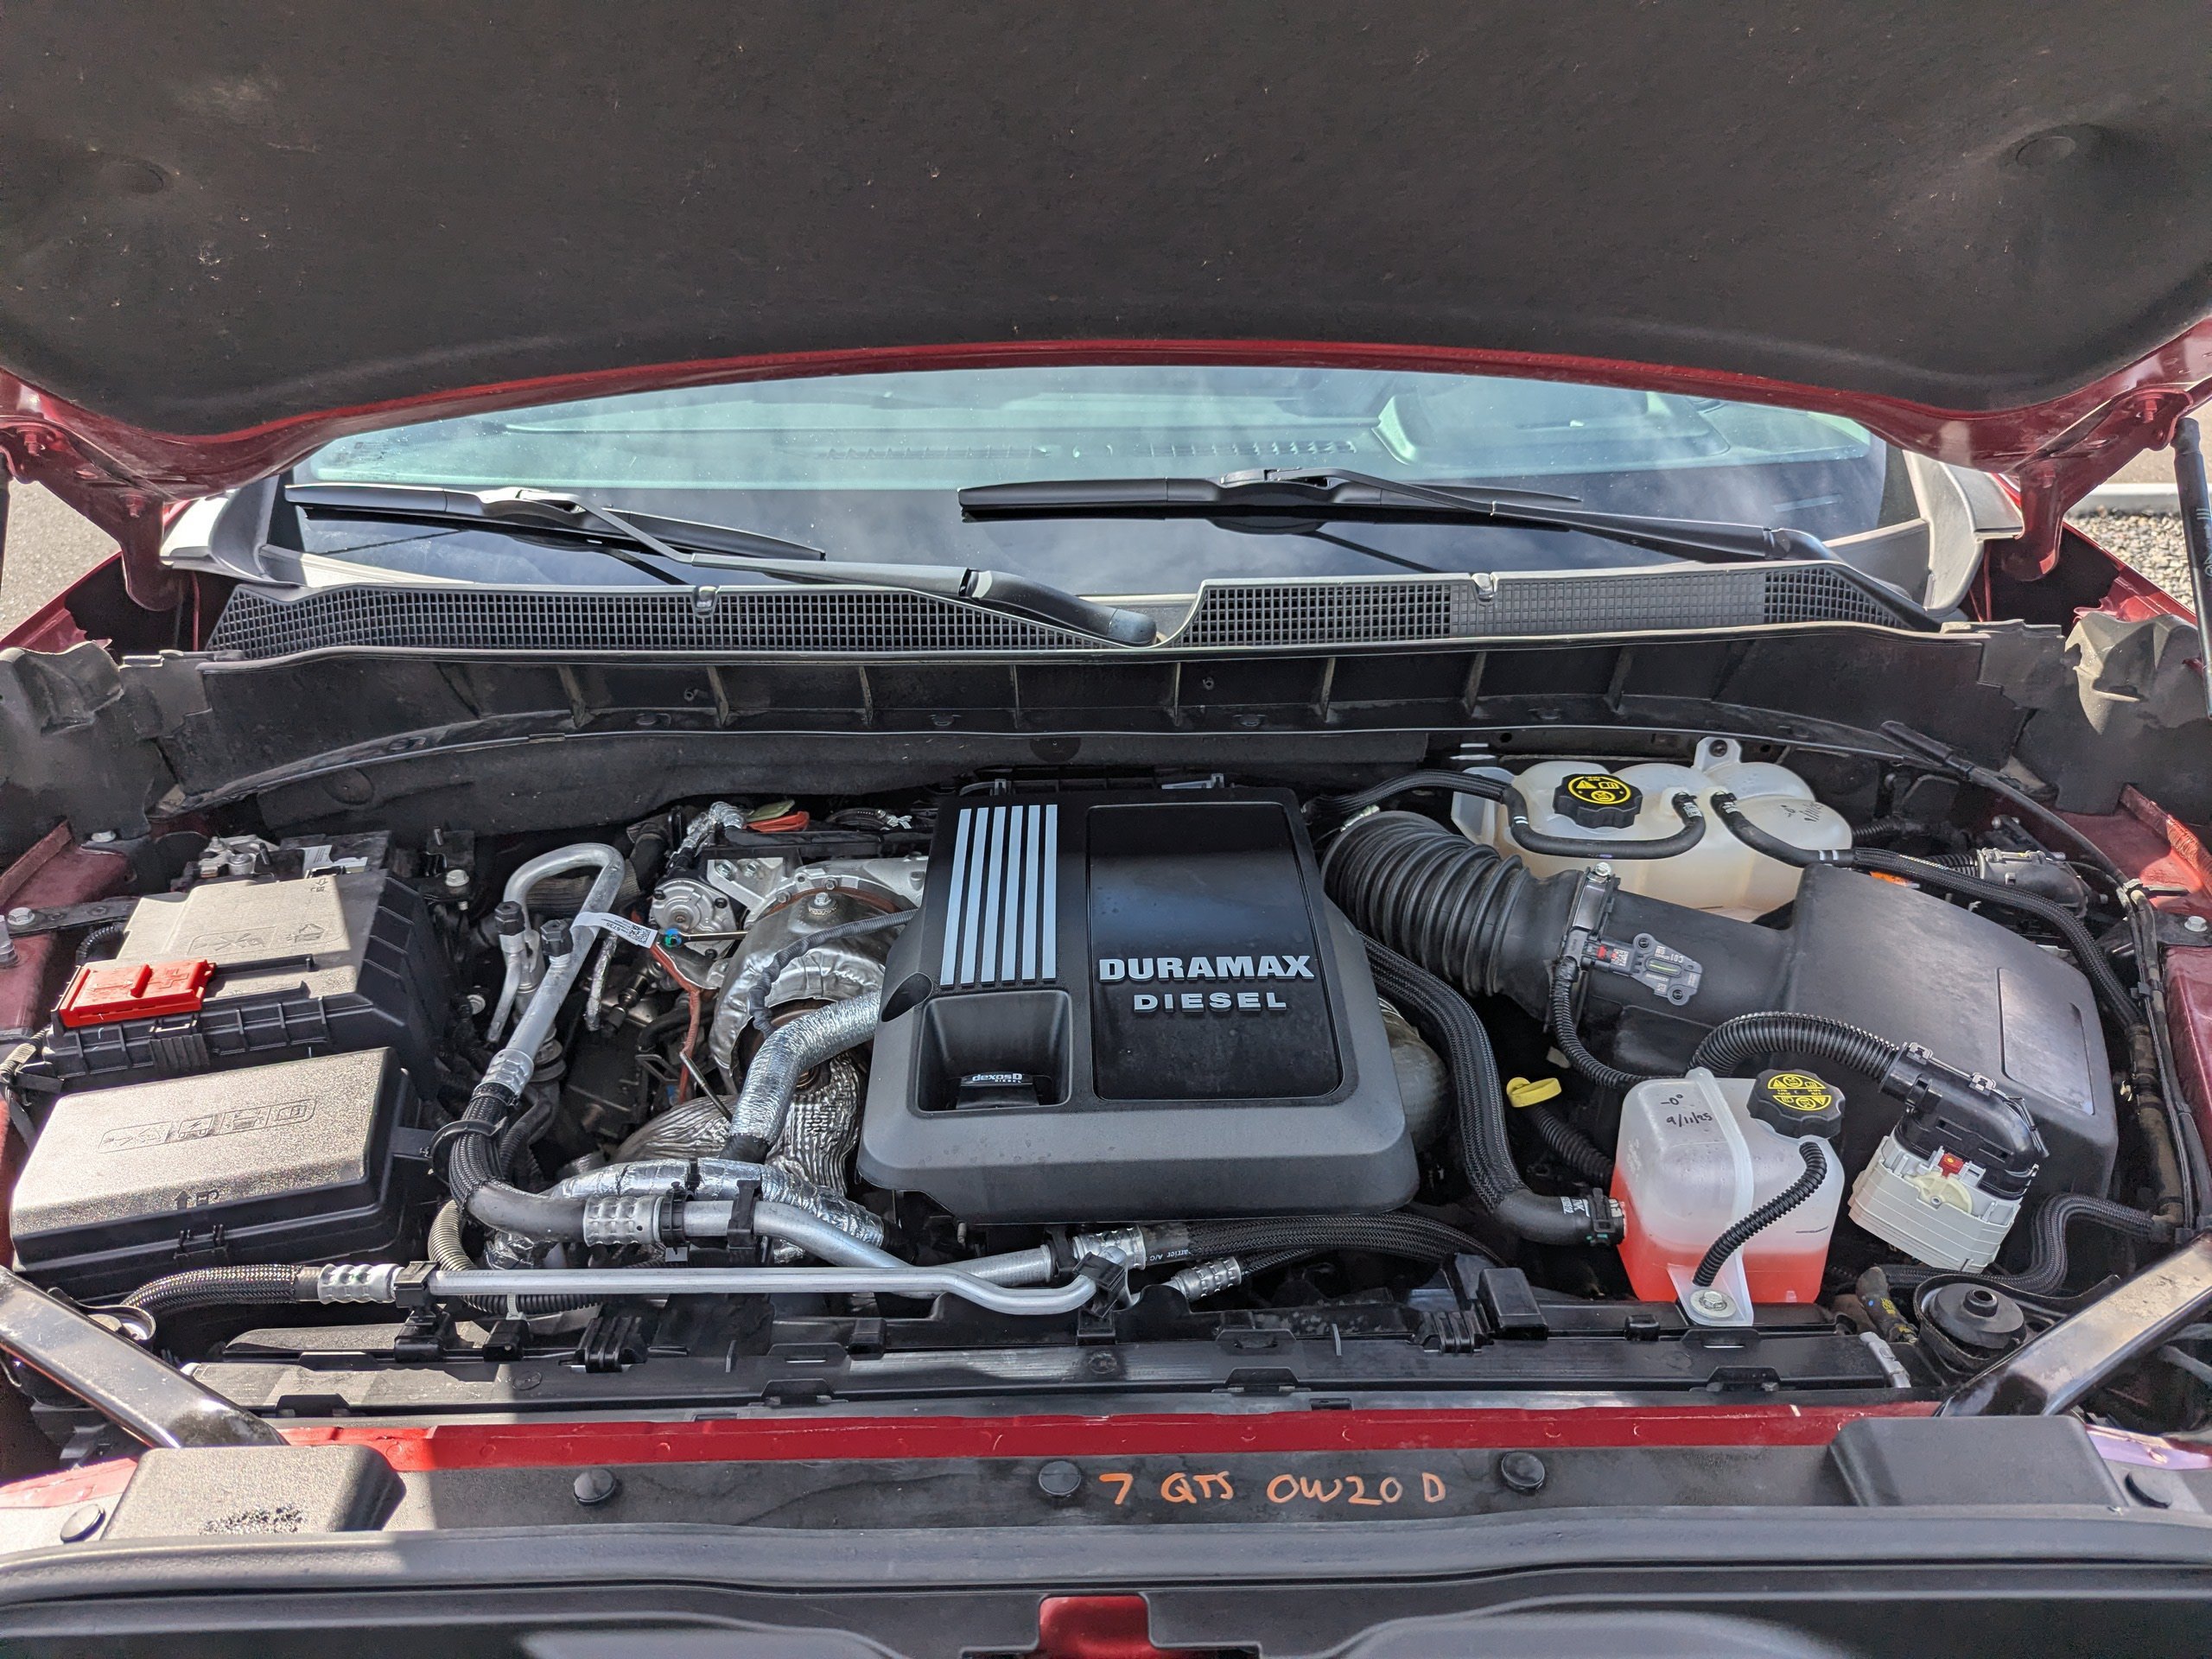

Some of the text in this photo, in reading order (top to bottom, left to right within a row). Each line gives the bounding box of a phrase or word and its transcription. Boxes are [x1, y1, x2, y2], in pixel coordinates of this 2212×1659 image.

[1099, 956, 1315, 982] DURAMAX
[1134, 992, 1287, 1013] DIESEL
[1666, 1111, 1713, 1128] 9/11/25
[1099, 1473, 1134, 1504] 7
[1160, 1471, 1235, 1503] QTS
[1422, 1472, 1446, 1503] D
